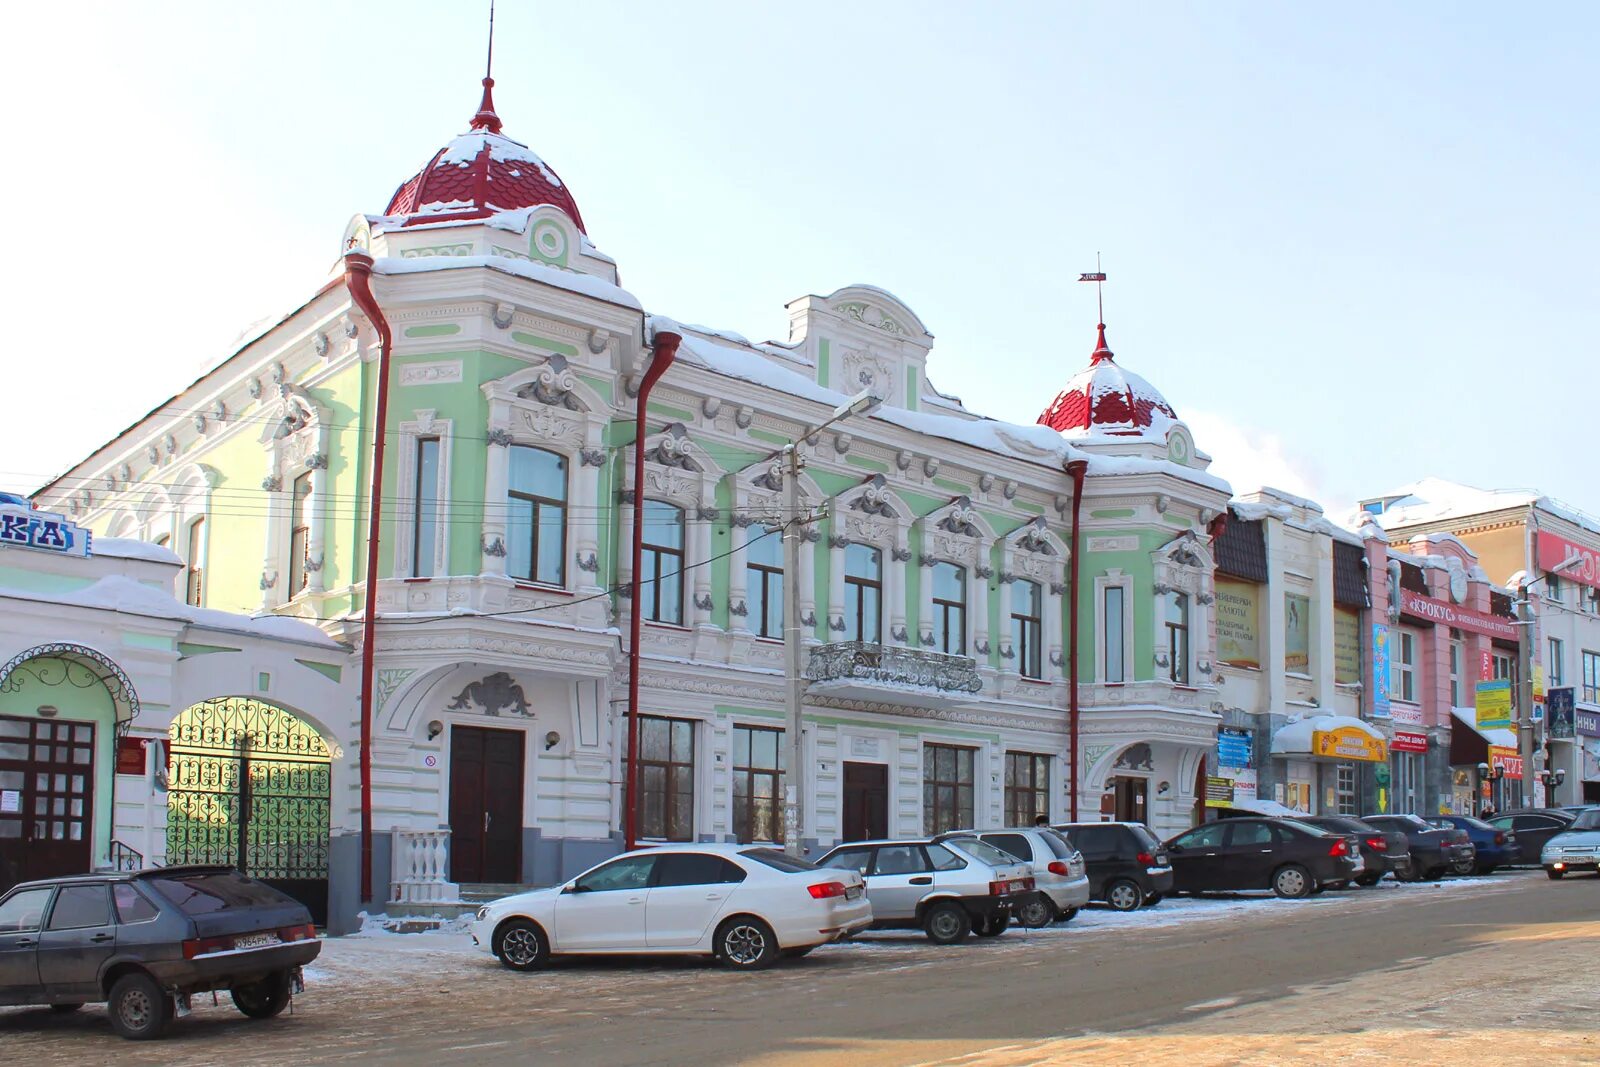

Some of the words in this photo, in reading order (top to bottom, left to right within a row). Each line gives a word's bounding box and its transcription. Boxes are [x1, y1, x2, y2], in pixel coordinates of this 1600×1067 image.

[1218, 605, 1247, 617] САЛЮТЫ
[1409, 598, 1456, 622] «КРОКУС»
[1458, 614, 1495, 630] ФИНАНСОВАЯ
[1495, 622, 1515, 635] ГРУППА
